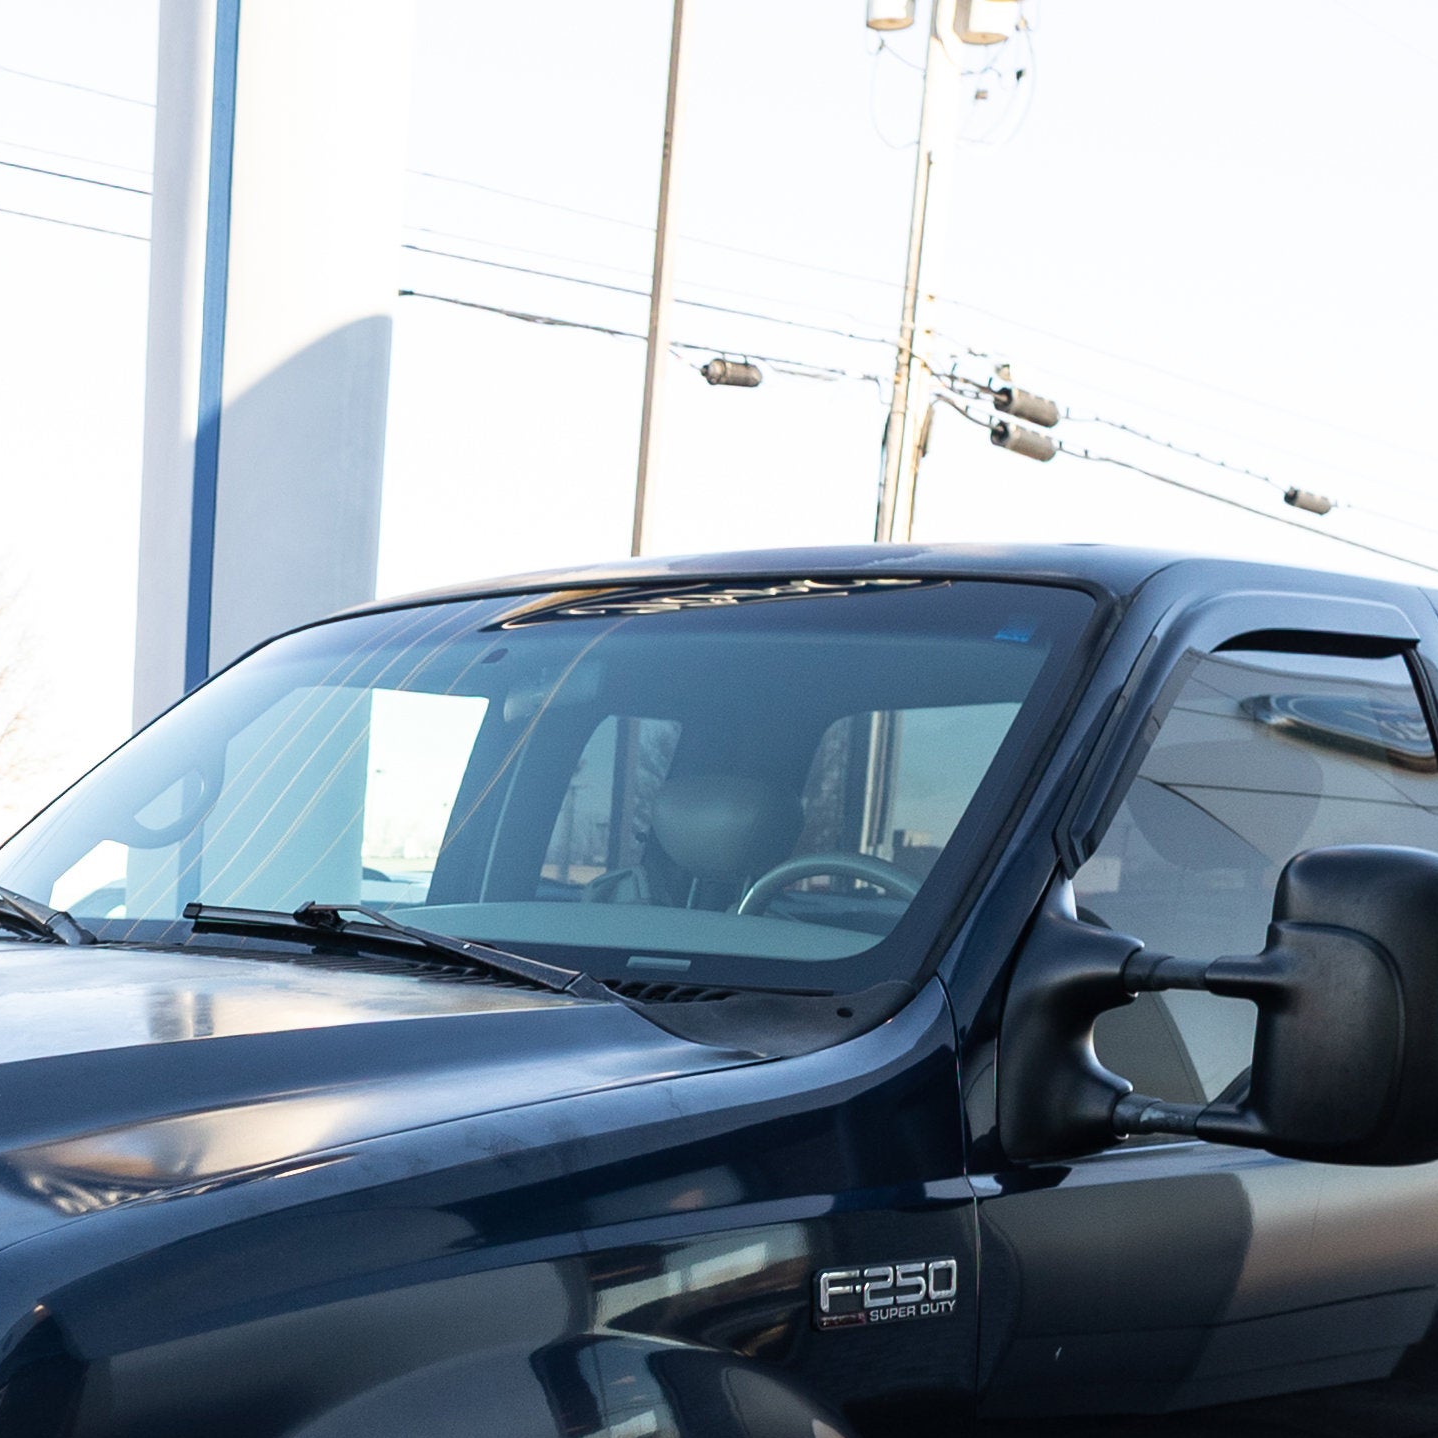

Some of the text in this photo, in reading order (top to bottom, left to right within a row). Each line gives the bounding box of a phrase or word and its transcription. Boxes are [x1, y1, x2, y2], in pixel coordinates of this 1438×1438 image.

[820, 1258, 957, 1313] F-250
[869, 1299, 957, 1322] SUPER DUTY
